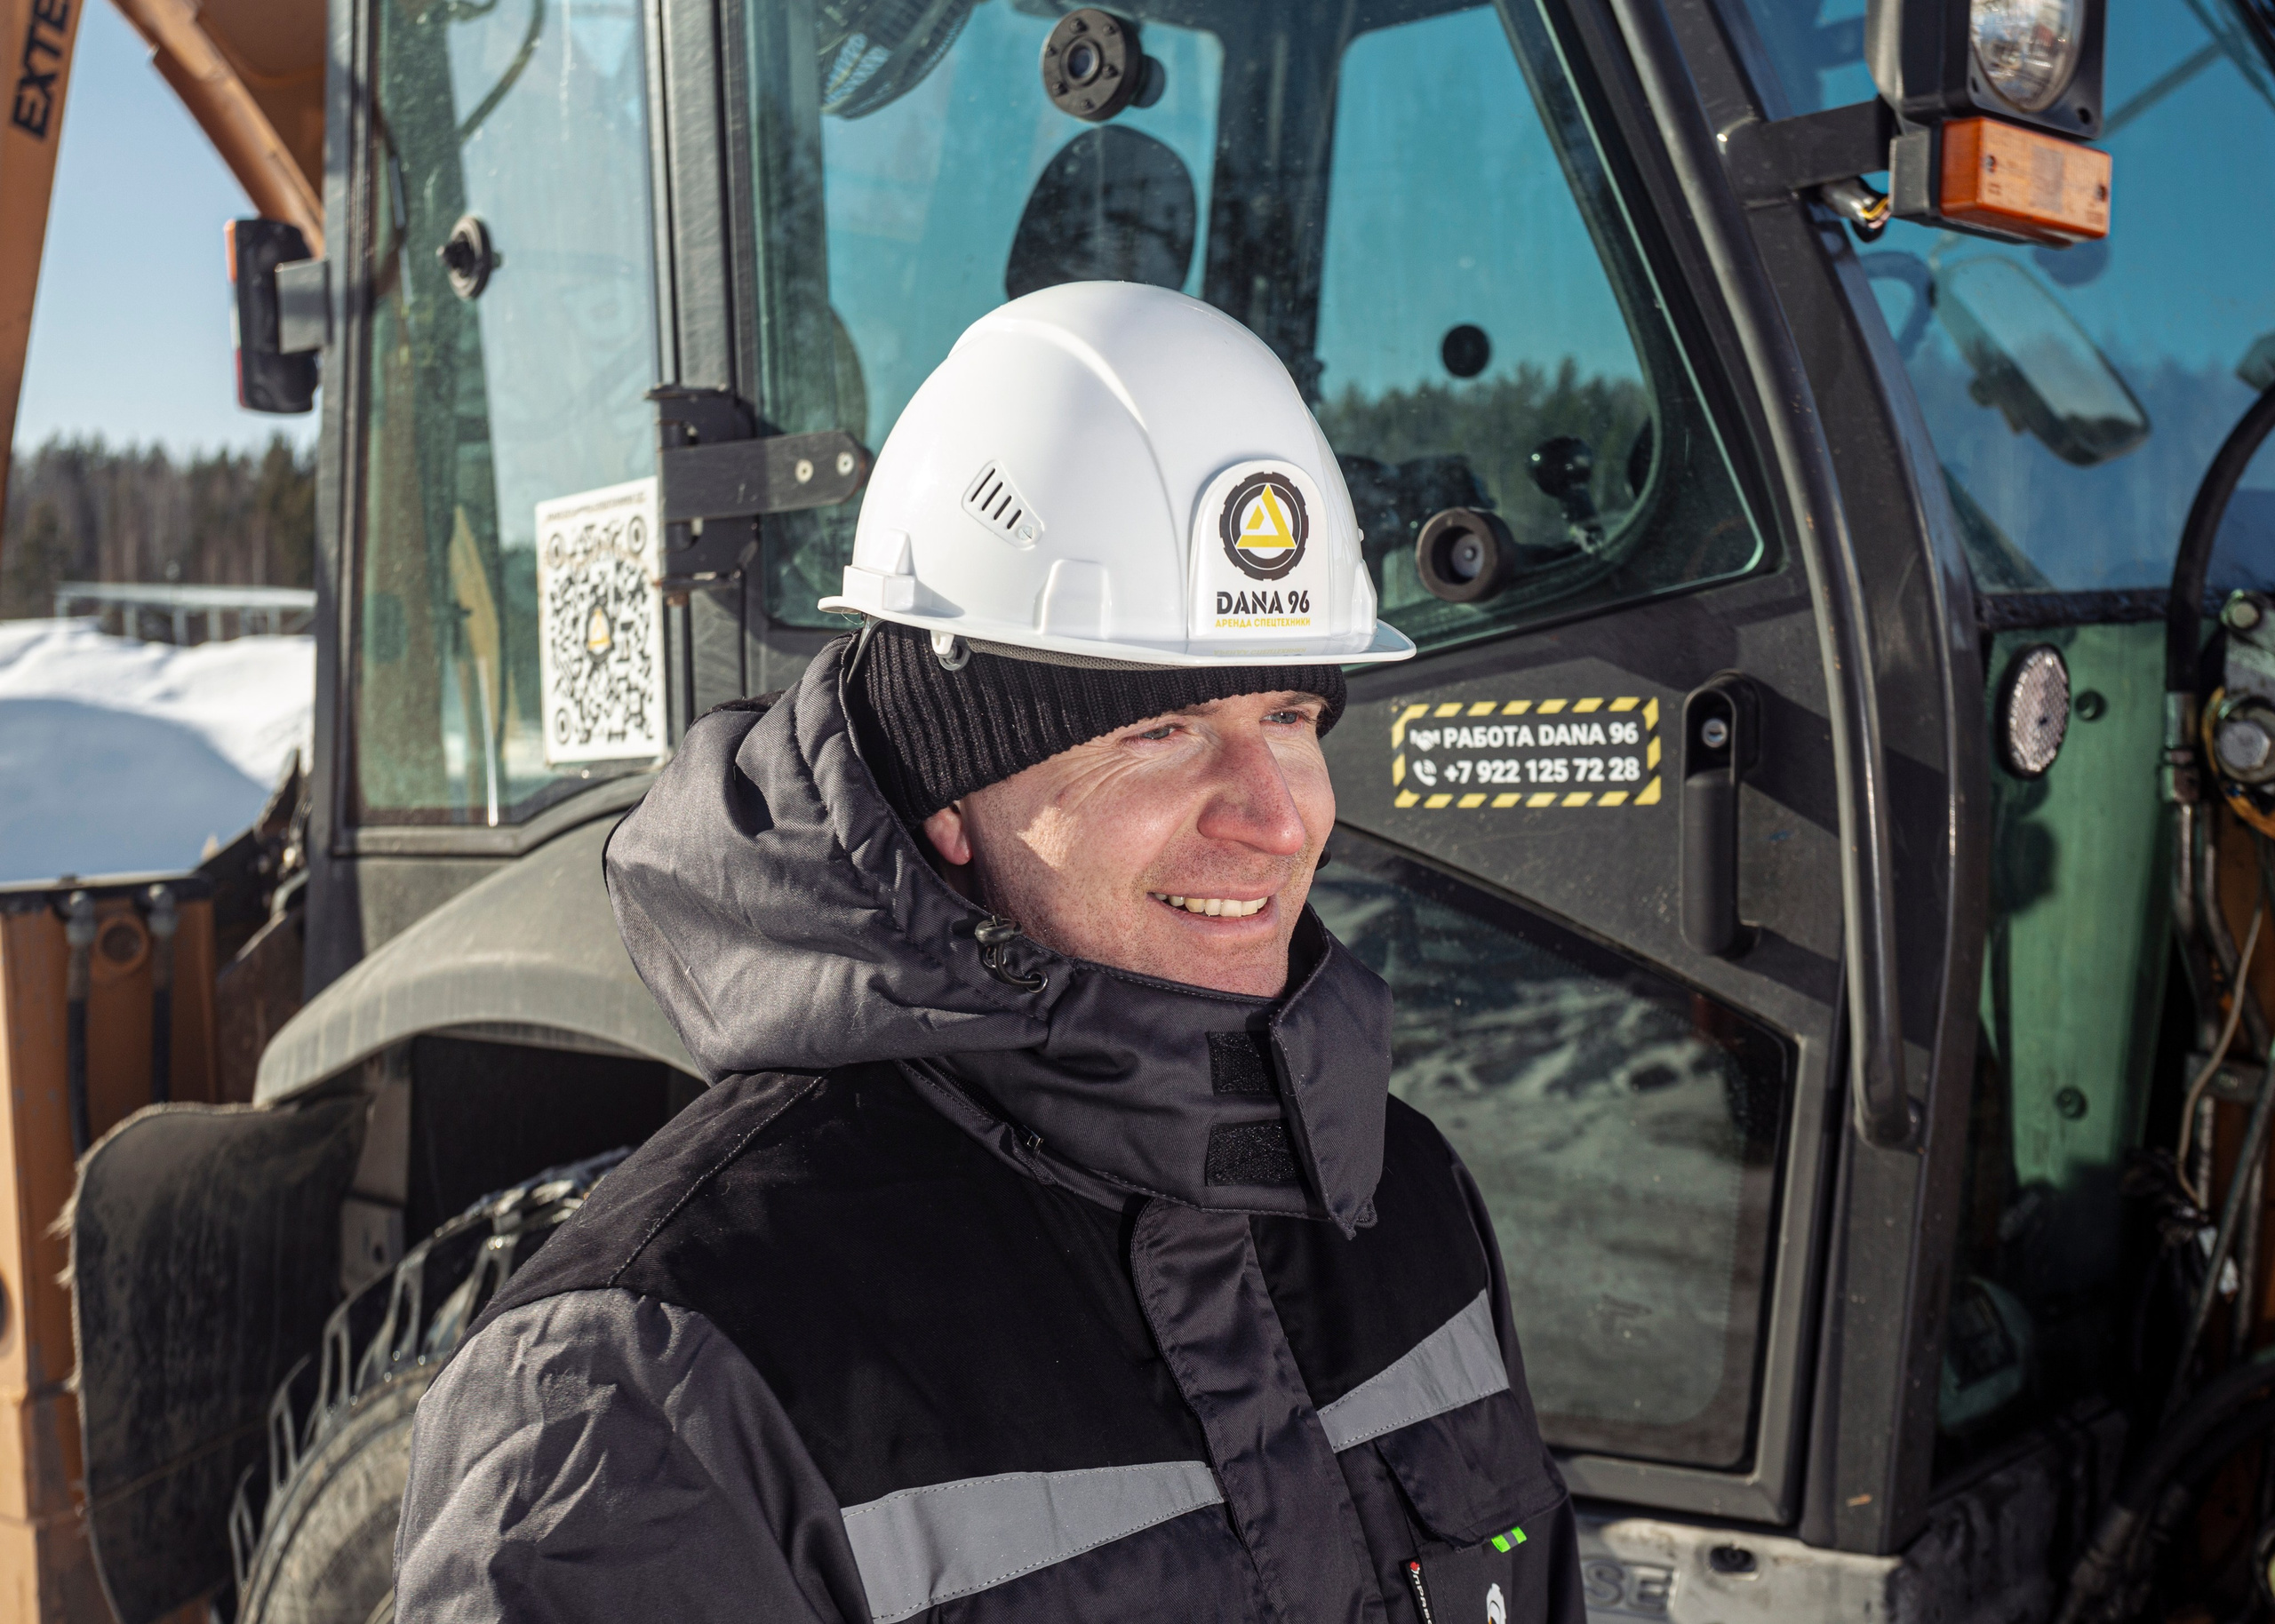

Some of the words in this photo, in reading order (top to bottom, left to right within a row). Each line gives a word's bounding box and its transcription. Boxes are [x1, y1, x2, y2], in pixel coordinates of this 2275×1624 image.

[1216, 590, 1284, 615] DANA
[1288, 590, 1310, 615] 96
[1215, 617, 1252, 628] АРЕНДА
[1254, 617, 1311, 628] СПЕЦТЕХНИКИ
[1442, 724, 1536, 749] РАБОТА
[1537, 722, 1607, 747] DANA
[1608, 720, 1640, 745] 96
[1443, 760, 1473, 784] +7
[1475, 759, 1521, 784] 922
[1524, 758, 1570, 783] 125
[1572, 757, 1606, 783] 72
[1608, 756, 1641, 782] 28
